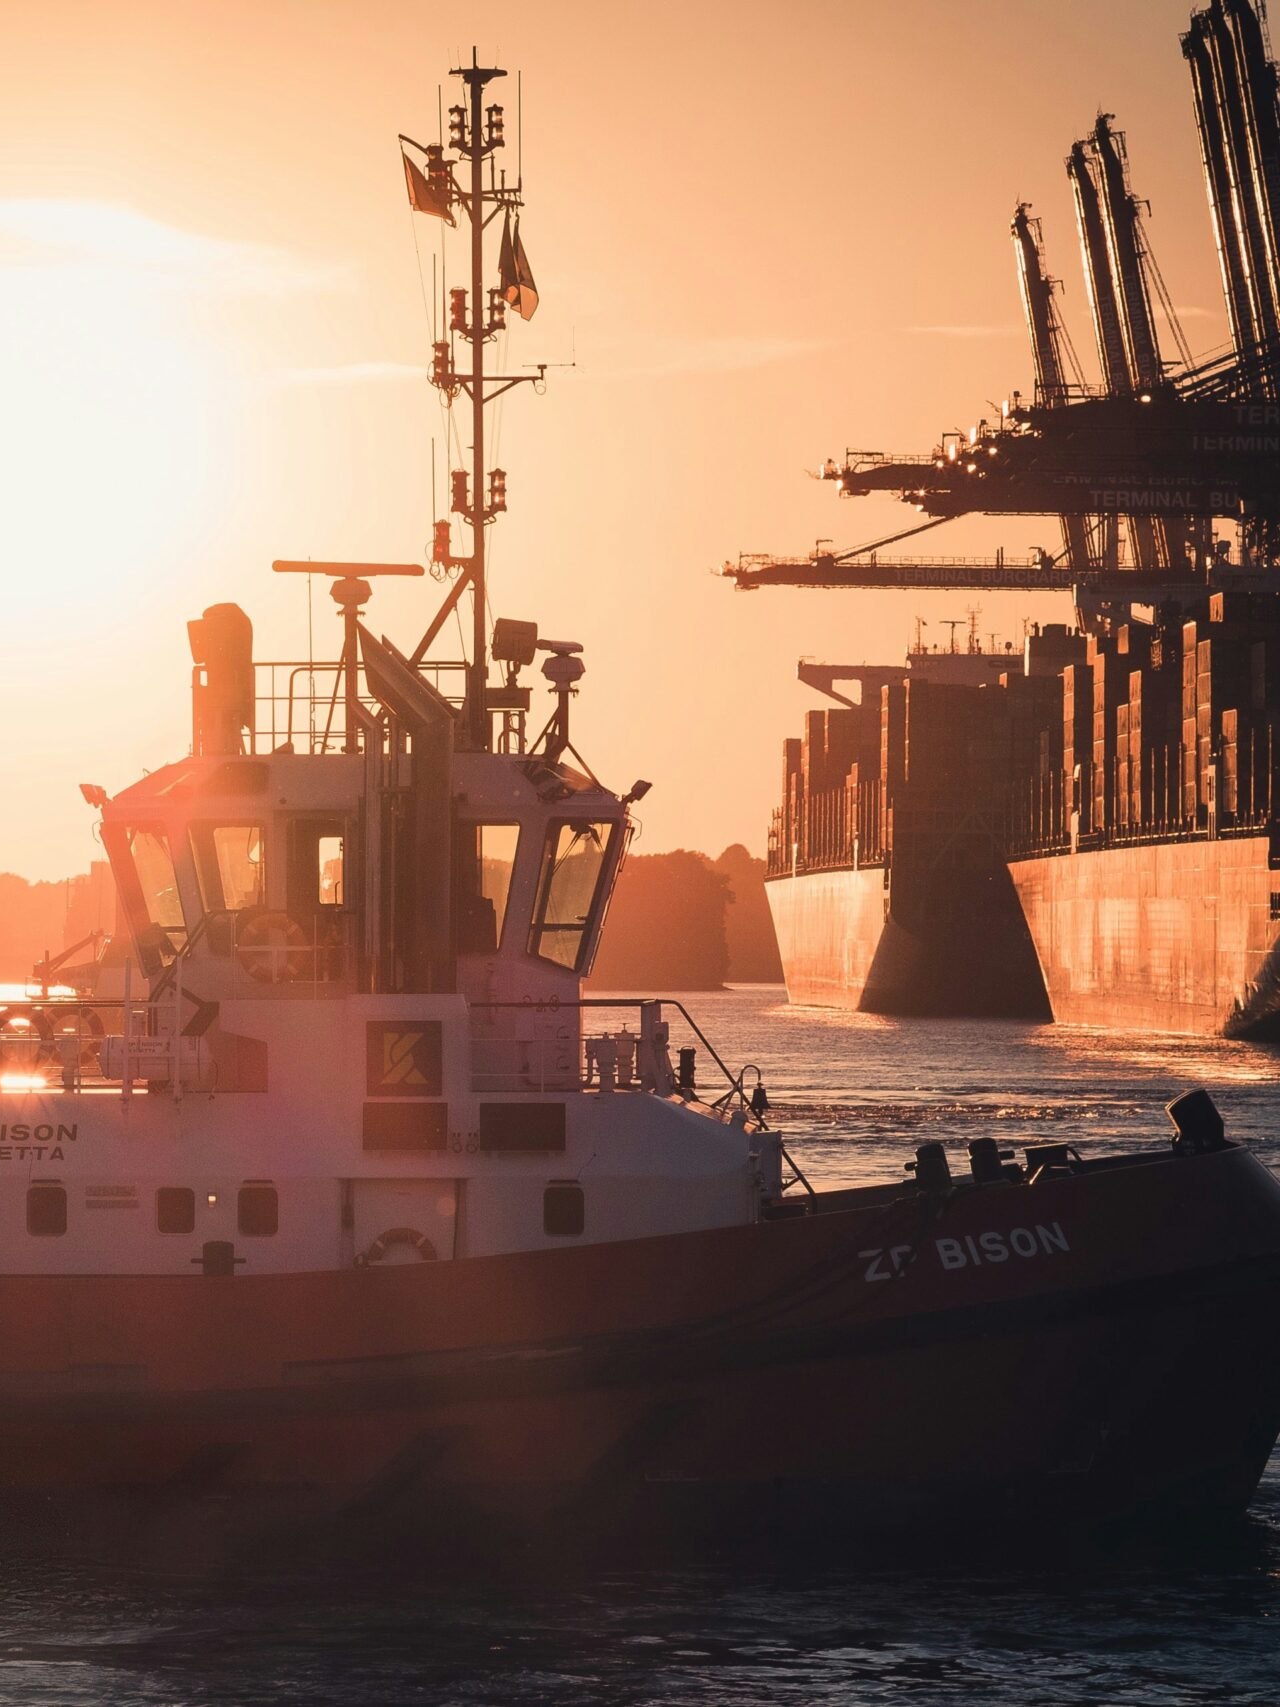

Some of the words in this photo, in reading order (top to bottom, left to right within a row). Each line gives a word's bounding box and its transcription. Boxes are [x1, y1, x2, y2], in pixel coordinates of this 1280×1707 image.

[1089, 490, 1197, 508] TERMINAL
[895, 571, 976, 584] TERMINAL
[857, 1244, 918, 1282] ZP
[934, 1221, 1071, 1270] BISON
